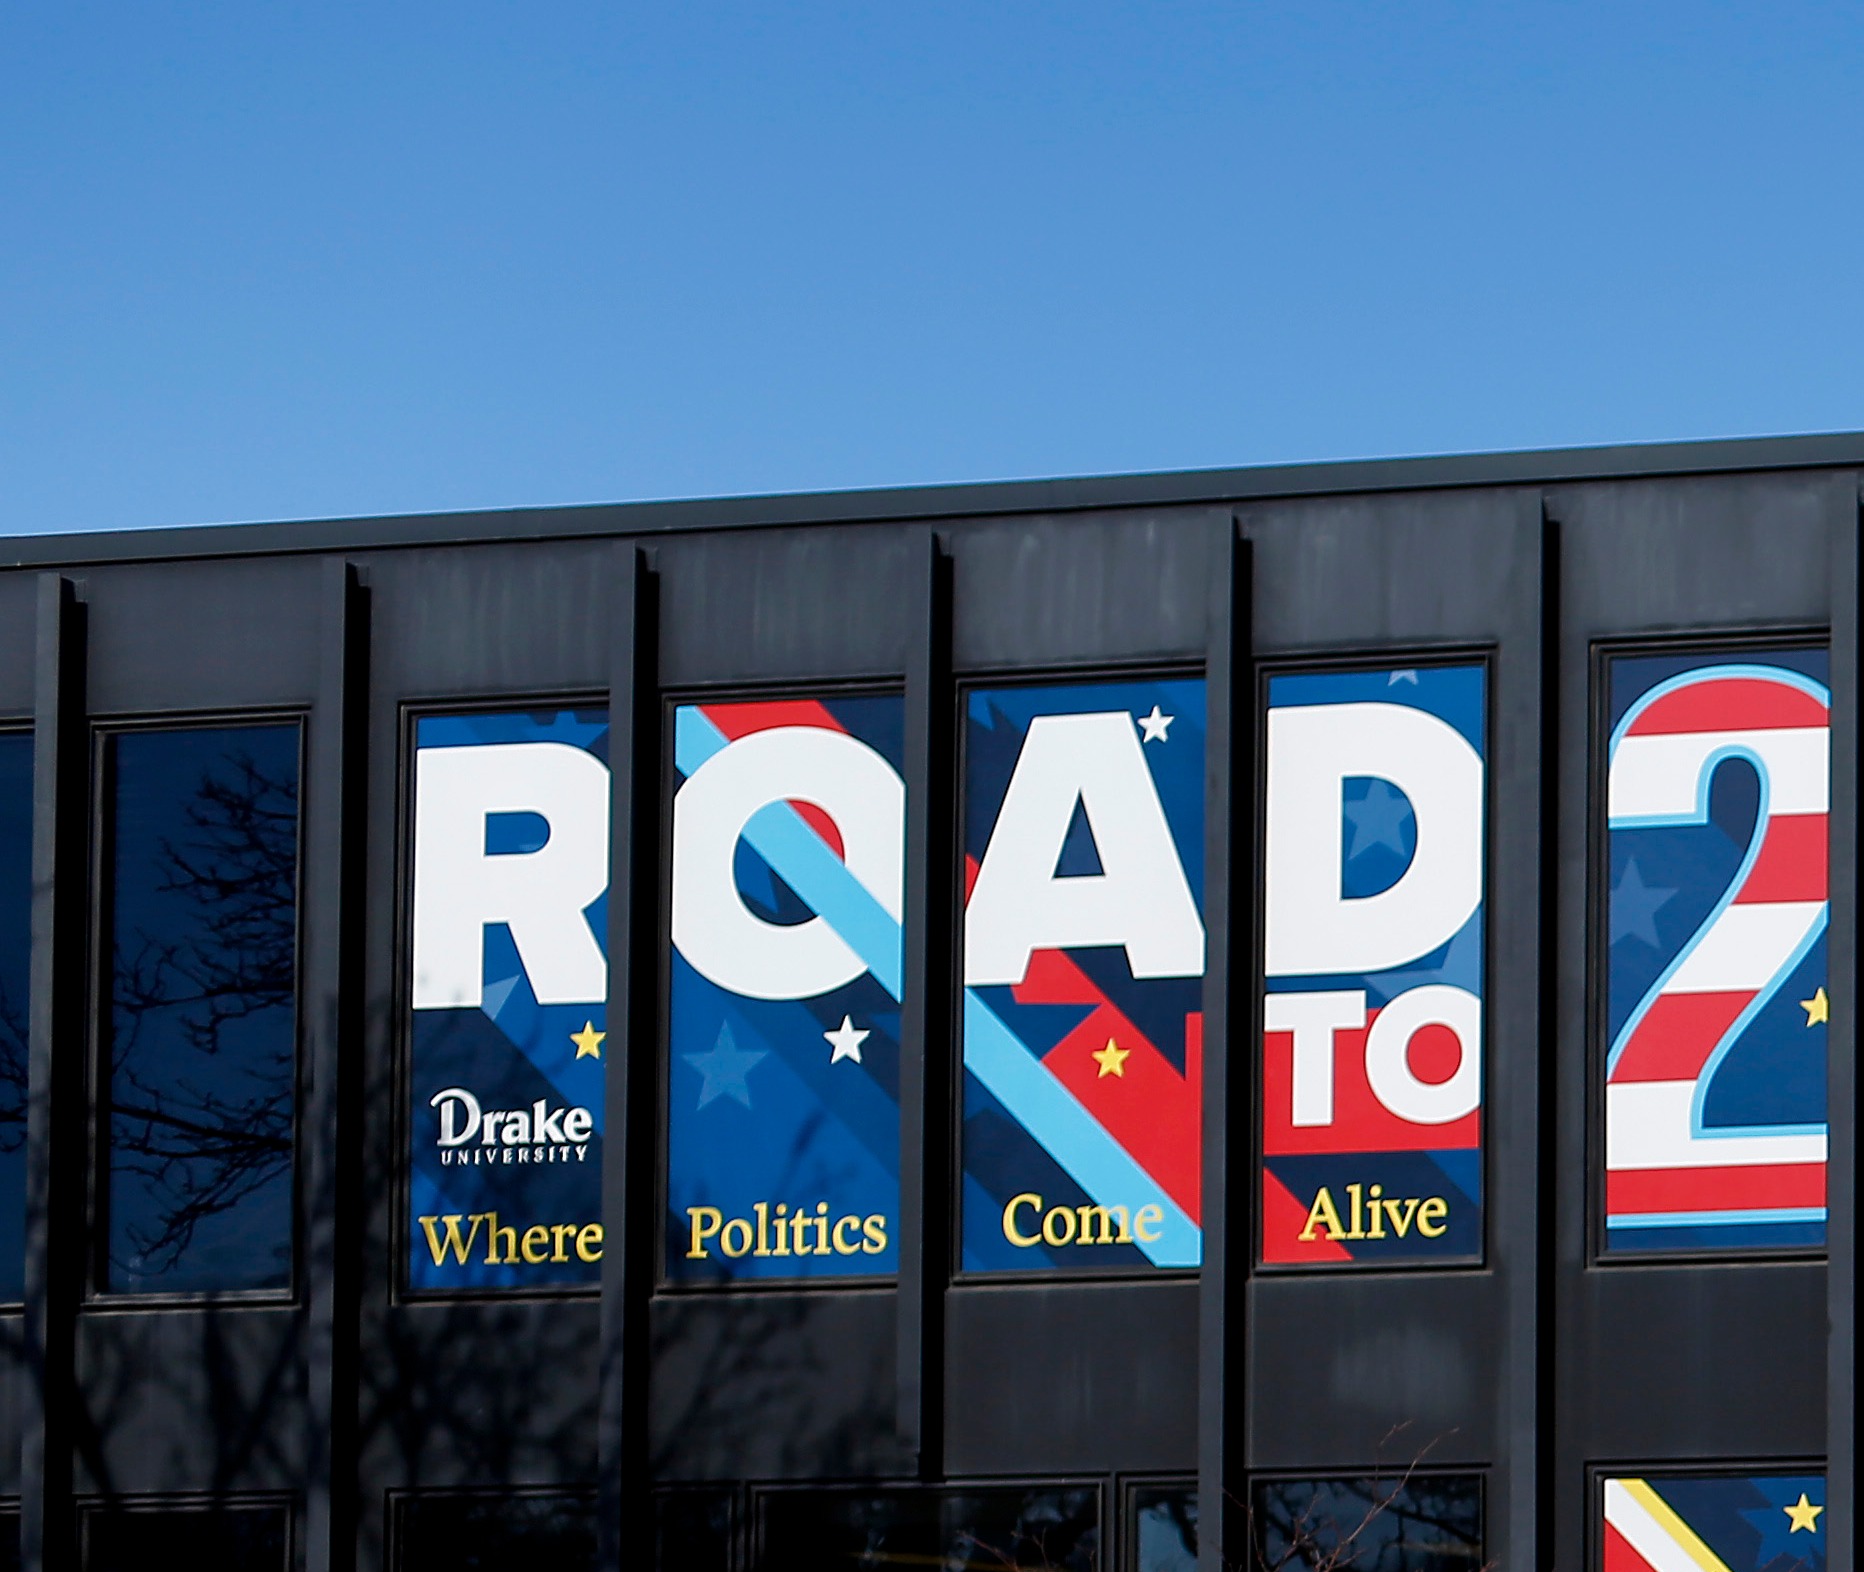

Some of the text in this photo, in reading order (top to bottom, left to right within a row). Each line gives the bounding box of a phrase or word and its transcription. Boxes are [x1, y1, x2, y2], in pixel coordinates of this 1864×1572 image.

[412, 700, 1483, 1010] ROAD
[1263, 982, 1481, 1126] TO
[430, 1087, 593, 1147] Drake
[441, 1144, 588, 1166] UNIVERSITY
[418, 1185, 1447, 1267] Where Politics Come Alive
